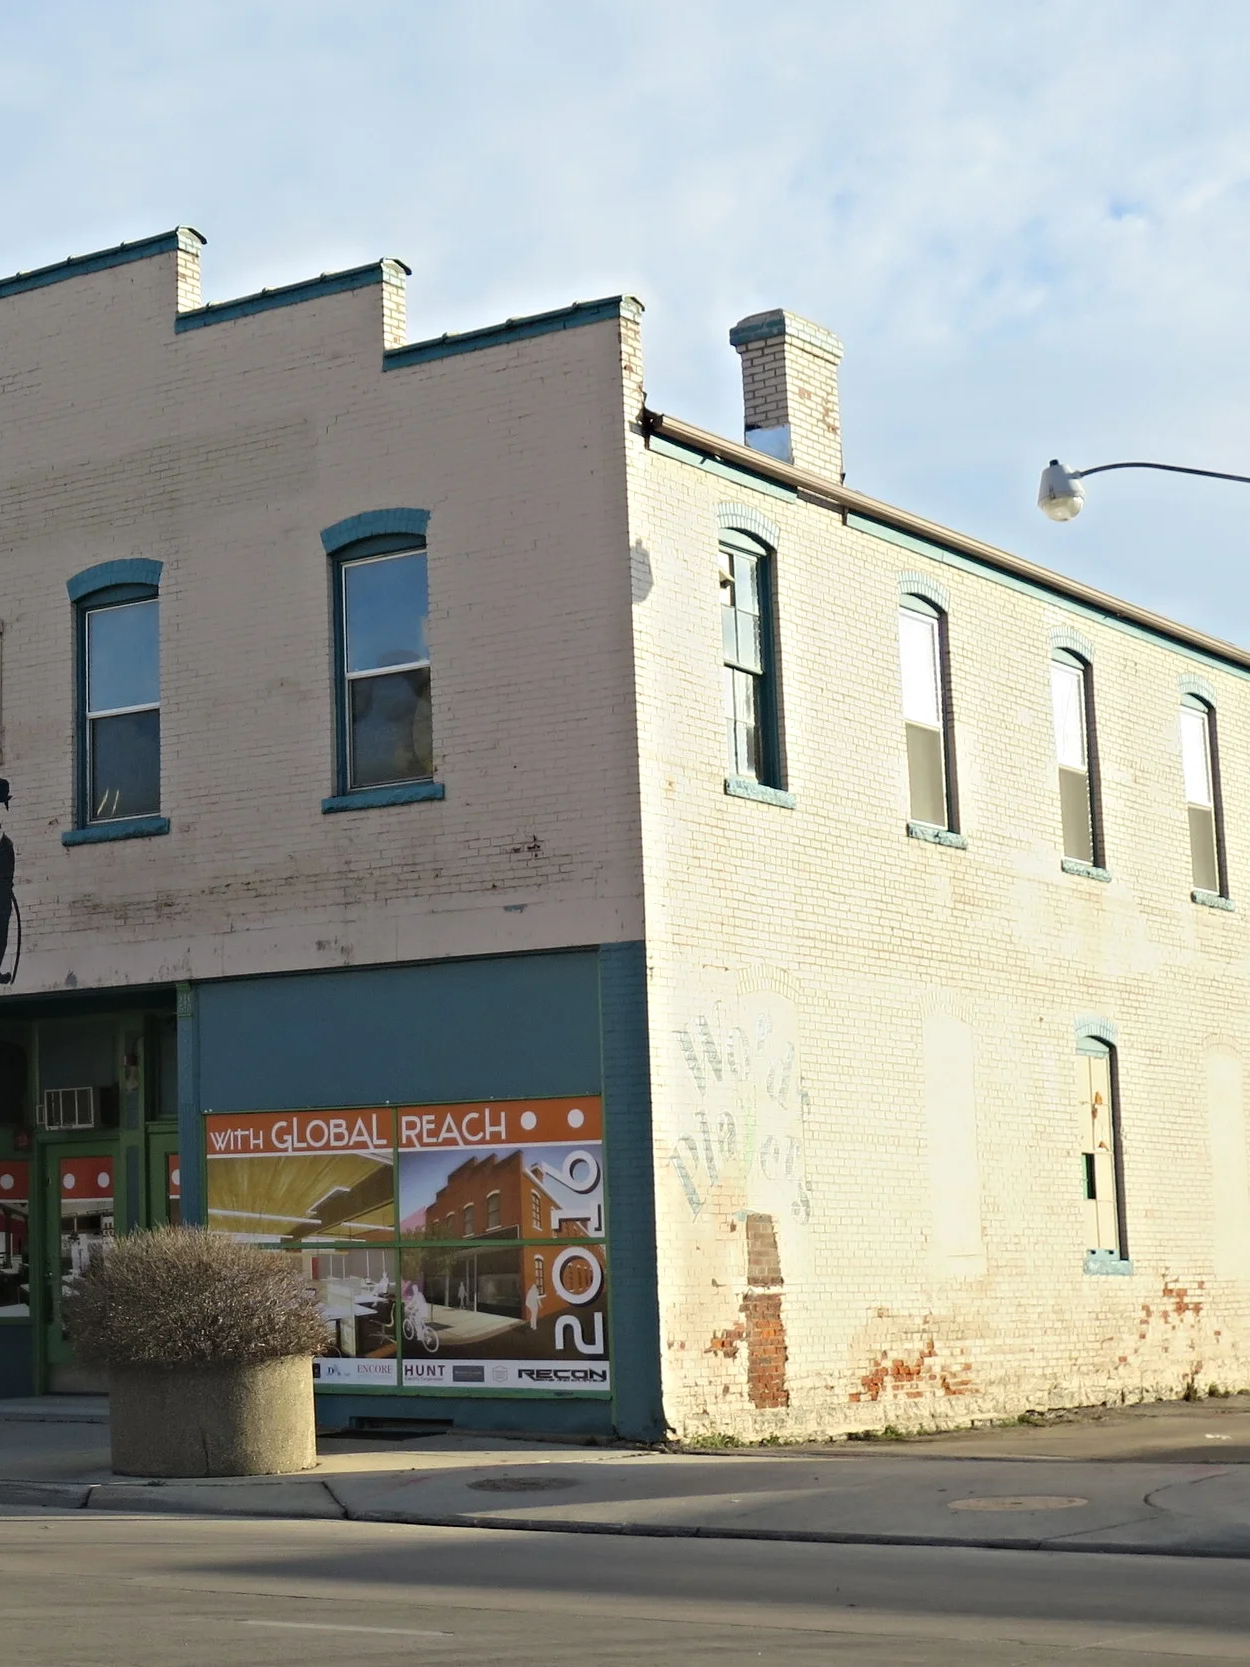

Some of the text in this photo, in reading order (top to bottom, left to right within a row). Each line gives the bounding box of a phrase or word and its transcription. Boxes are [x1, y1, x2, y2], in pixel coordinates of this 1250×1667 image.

[210, 1108, 506, 1152] WITH GLOBAL REACH
[542, 1150, 604, 1354] 2016
[357, 1364, 394, 1375] ENCORE
[404, 1364, 446, 1377] HUNT
[517, 1366, 608, 1383] RECON
